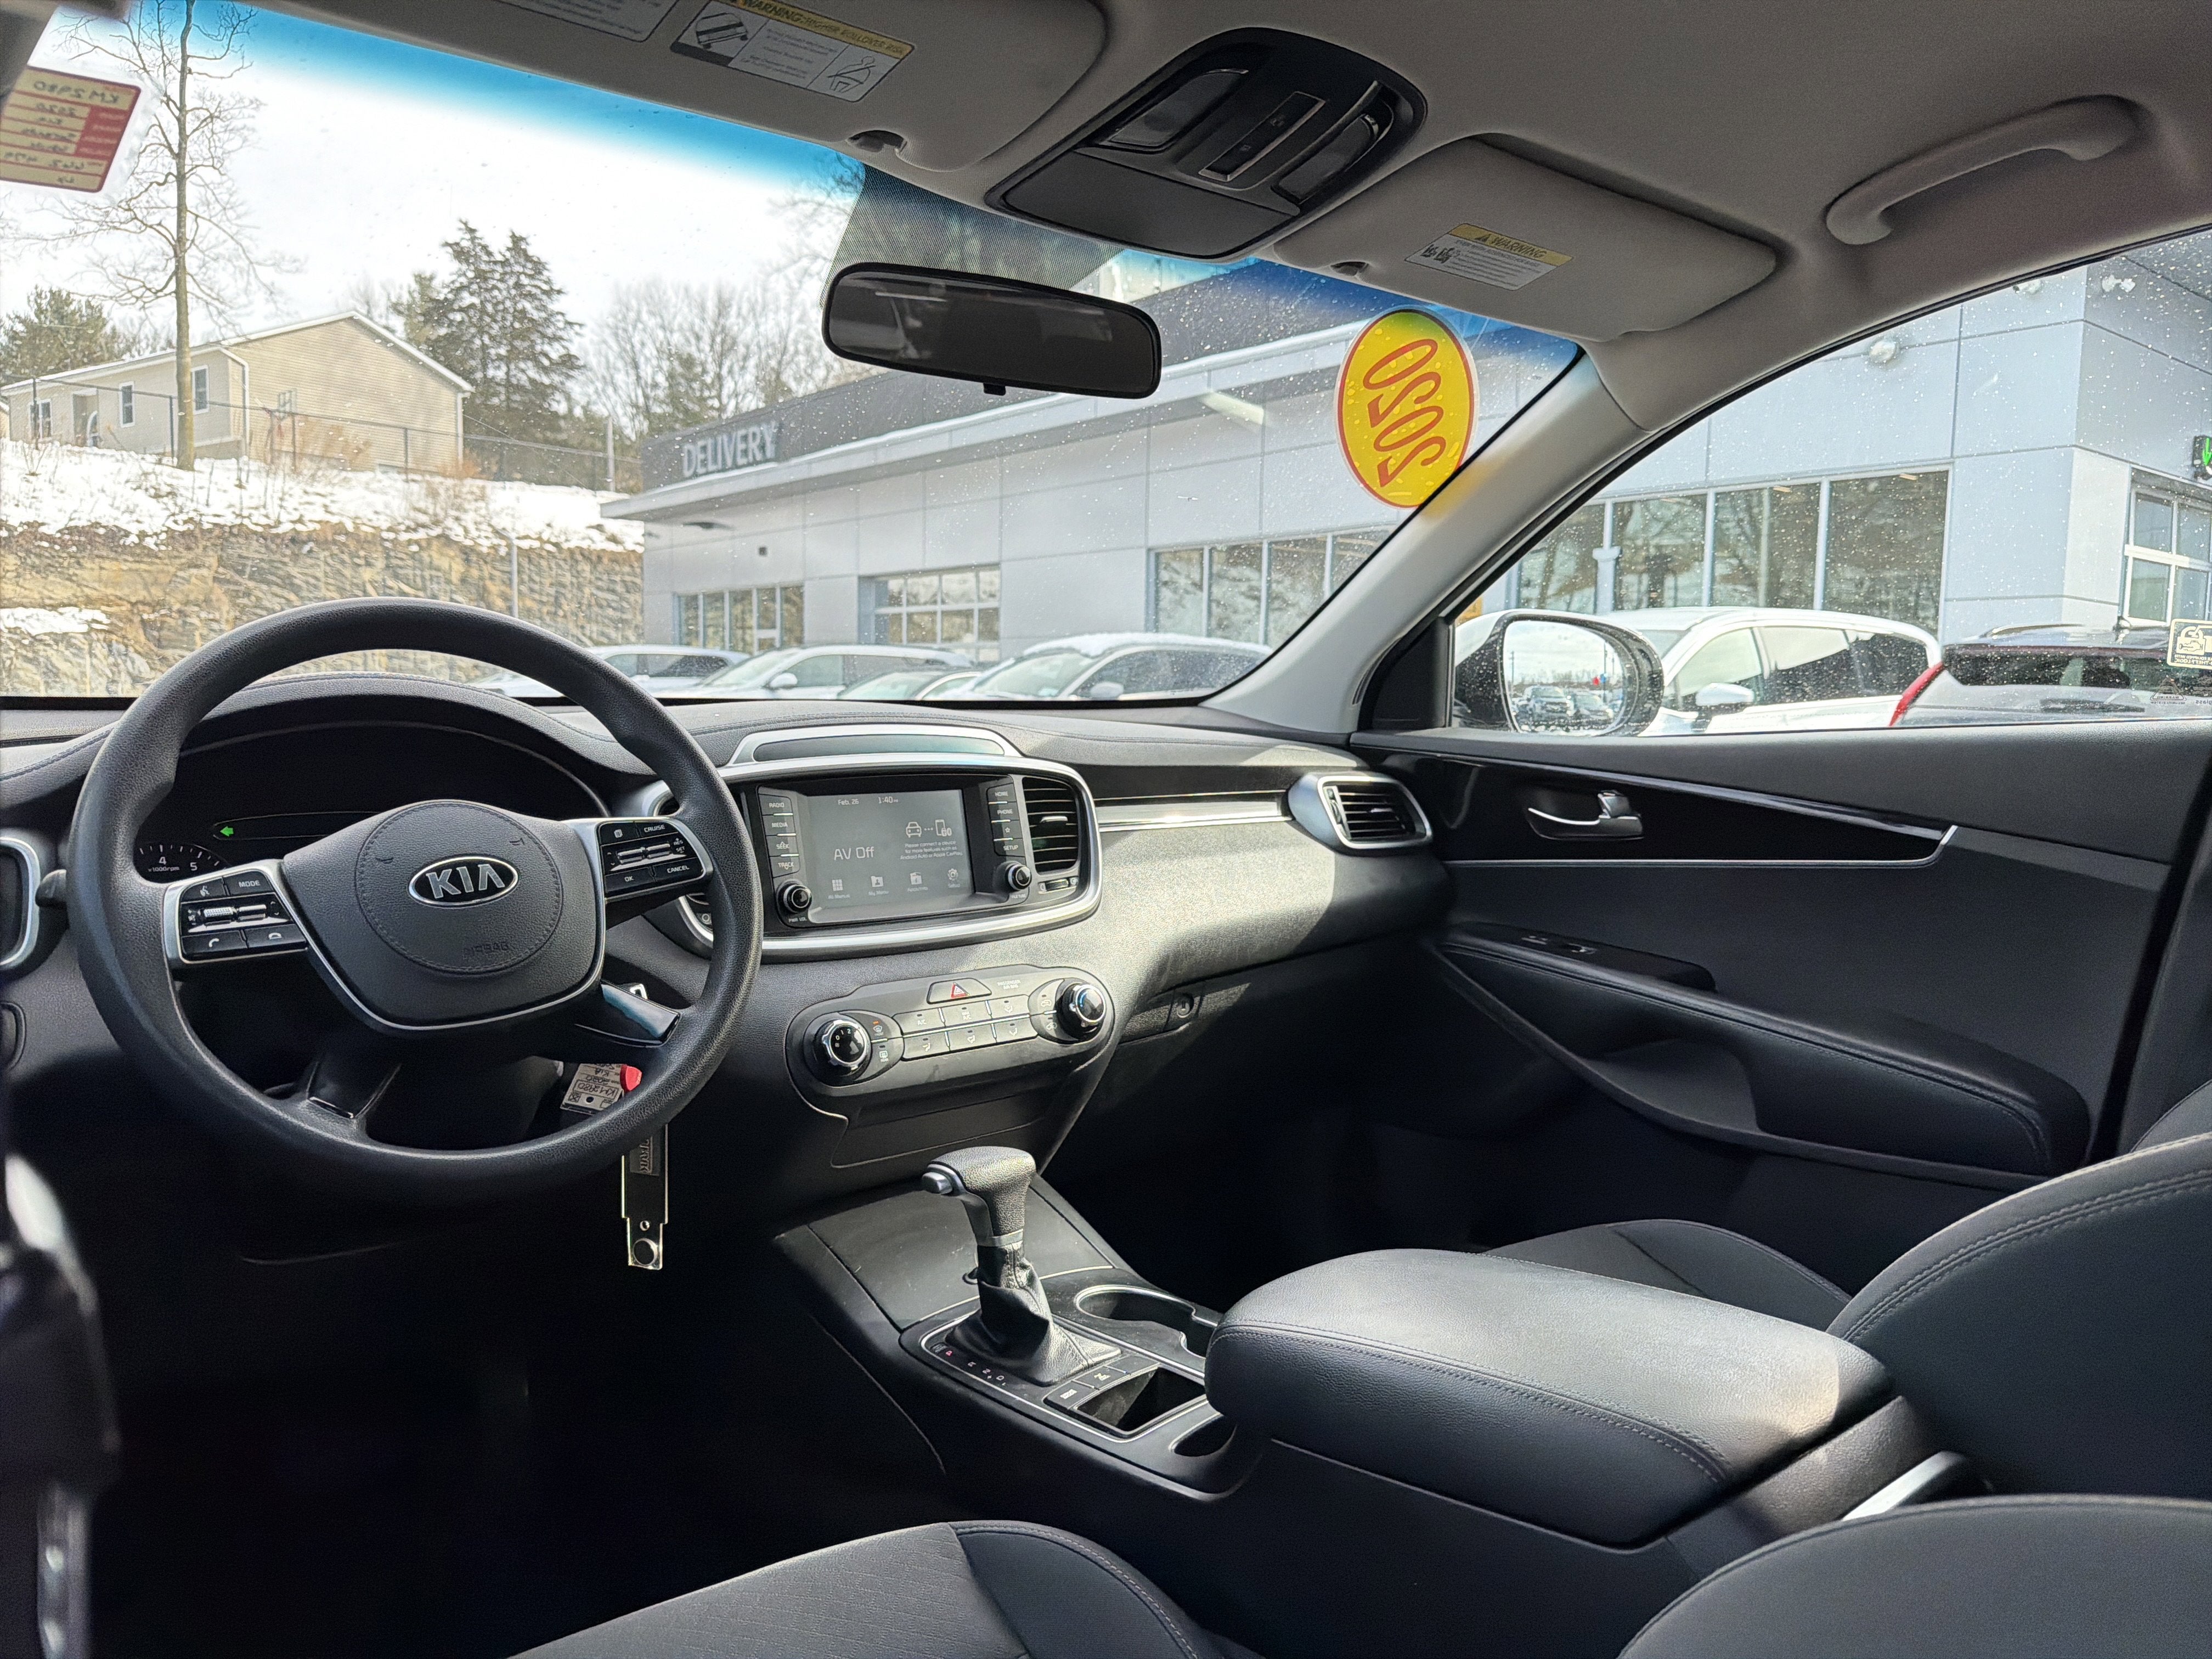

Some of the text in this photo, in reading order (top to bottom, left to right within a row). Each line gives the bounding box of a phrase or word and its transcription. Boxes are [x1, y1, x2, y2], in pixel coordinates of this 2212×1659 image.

[1491, 236, 1548, 258] WARNING
[682, 420, 779, 478] DELIVERY
[644, 825, 665, 833] CRUISE
[159, 856, 167, 865] 4
[834, 847, 875, 861] AV Off
[190, 862, 198, 871] 5
[667, 865, 690, 873] CANCEL
[426, 864, 505, 899] KIA
[578, 1082, 616, 1097] KM2980
